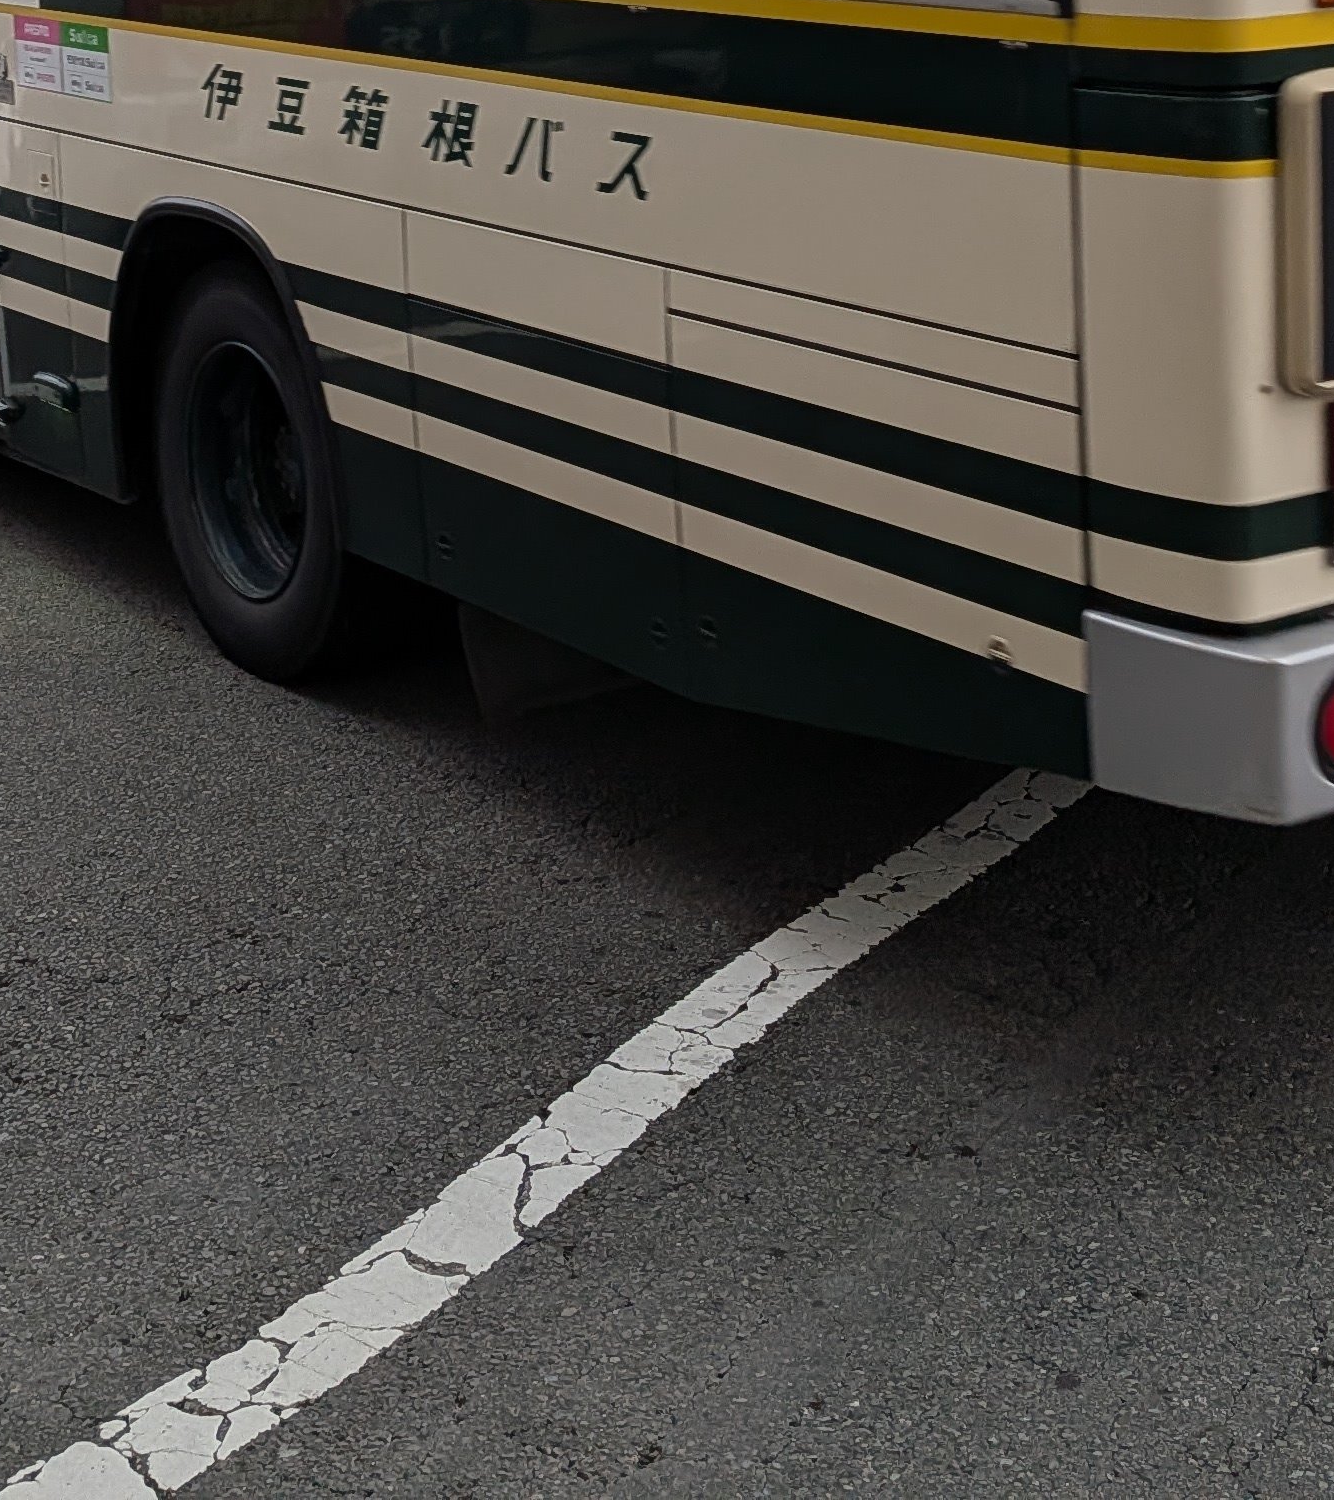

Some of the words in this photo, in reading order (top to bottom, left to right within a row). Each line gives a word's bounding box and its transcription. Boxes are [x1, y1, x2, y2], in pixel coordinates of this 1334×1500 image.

[201, 63, 654, 200] 伊豆箱根バス
